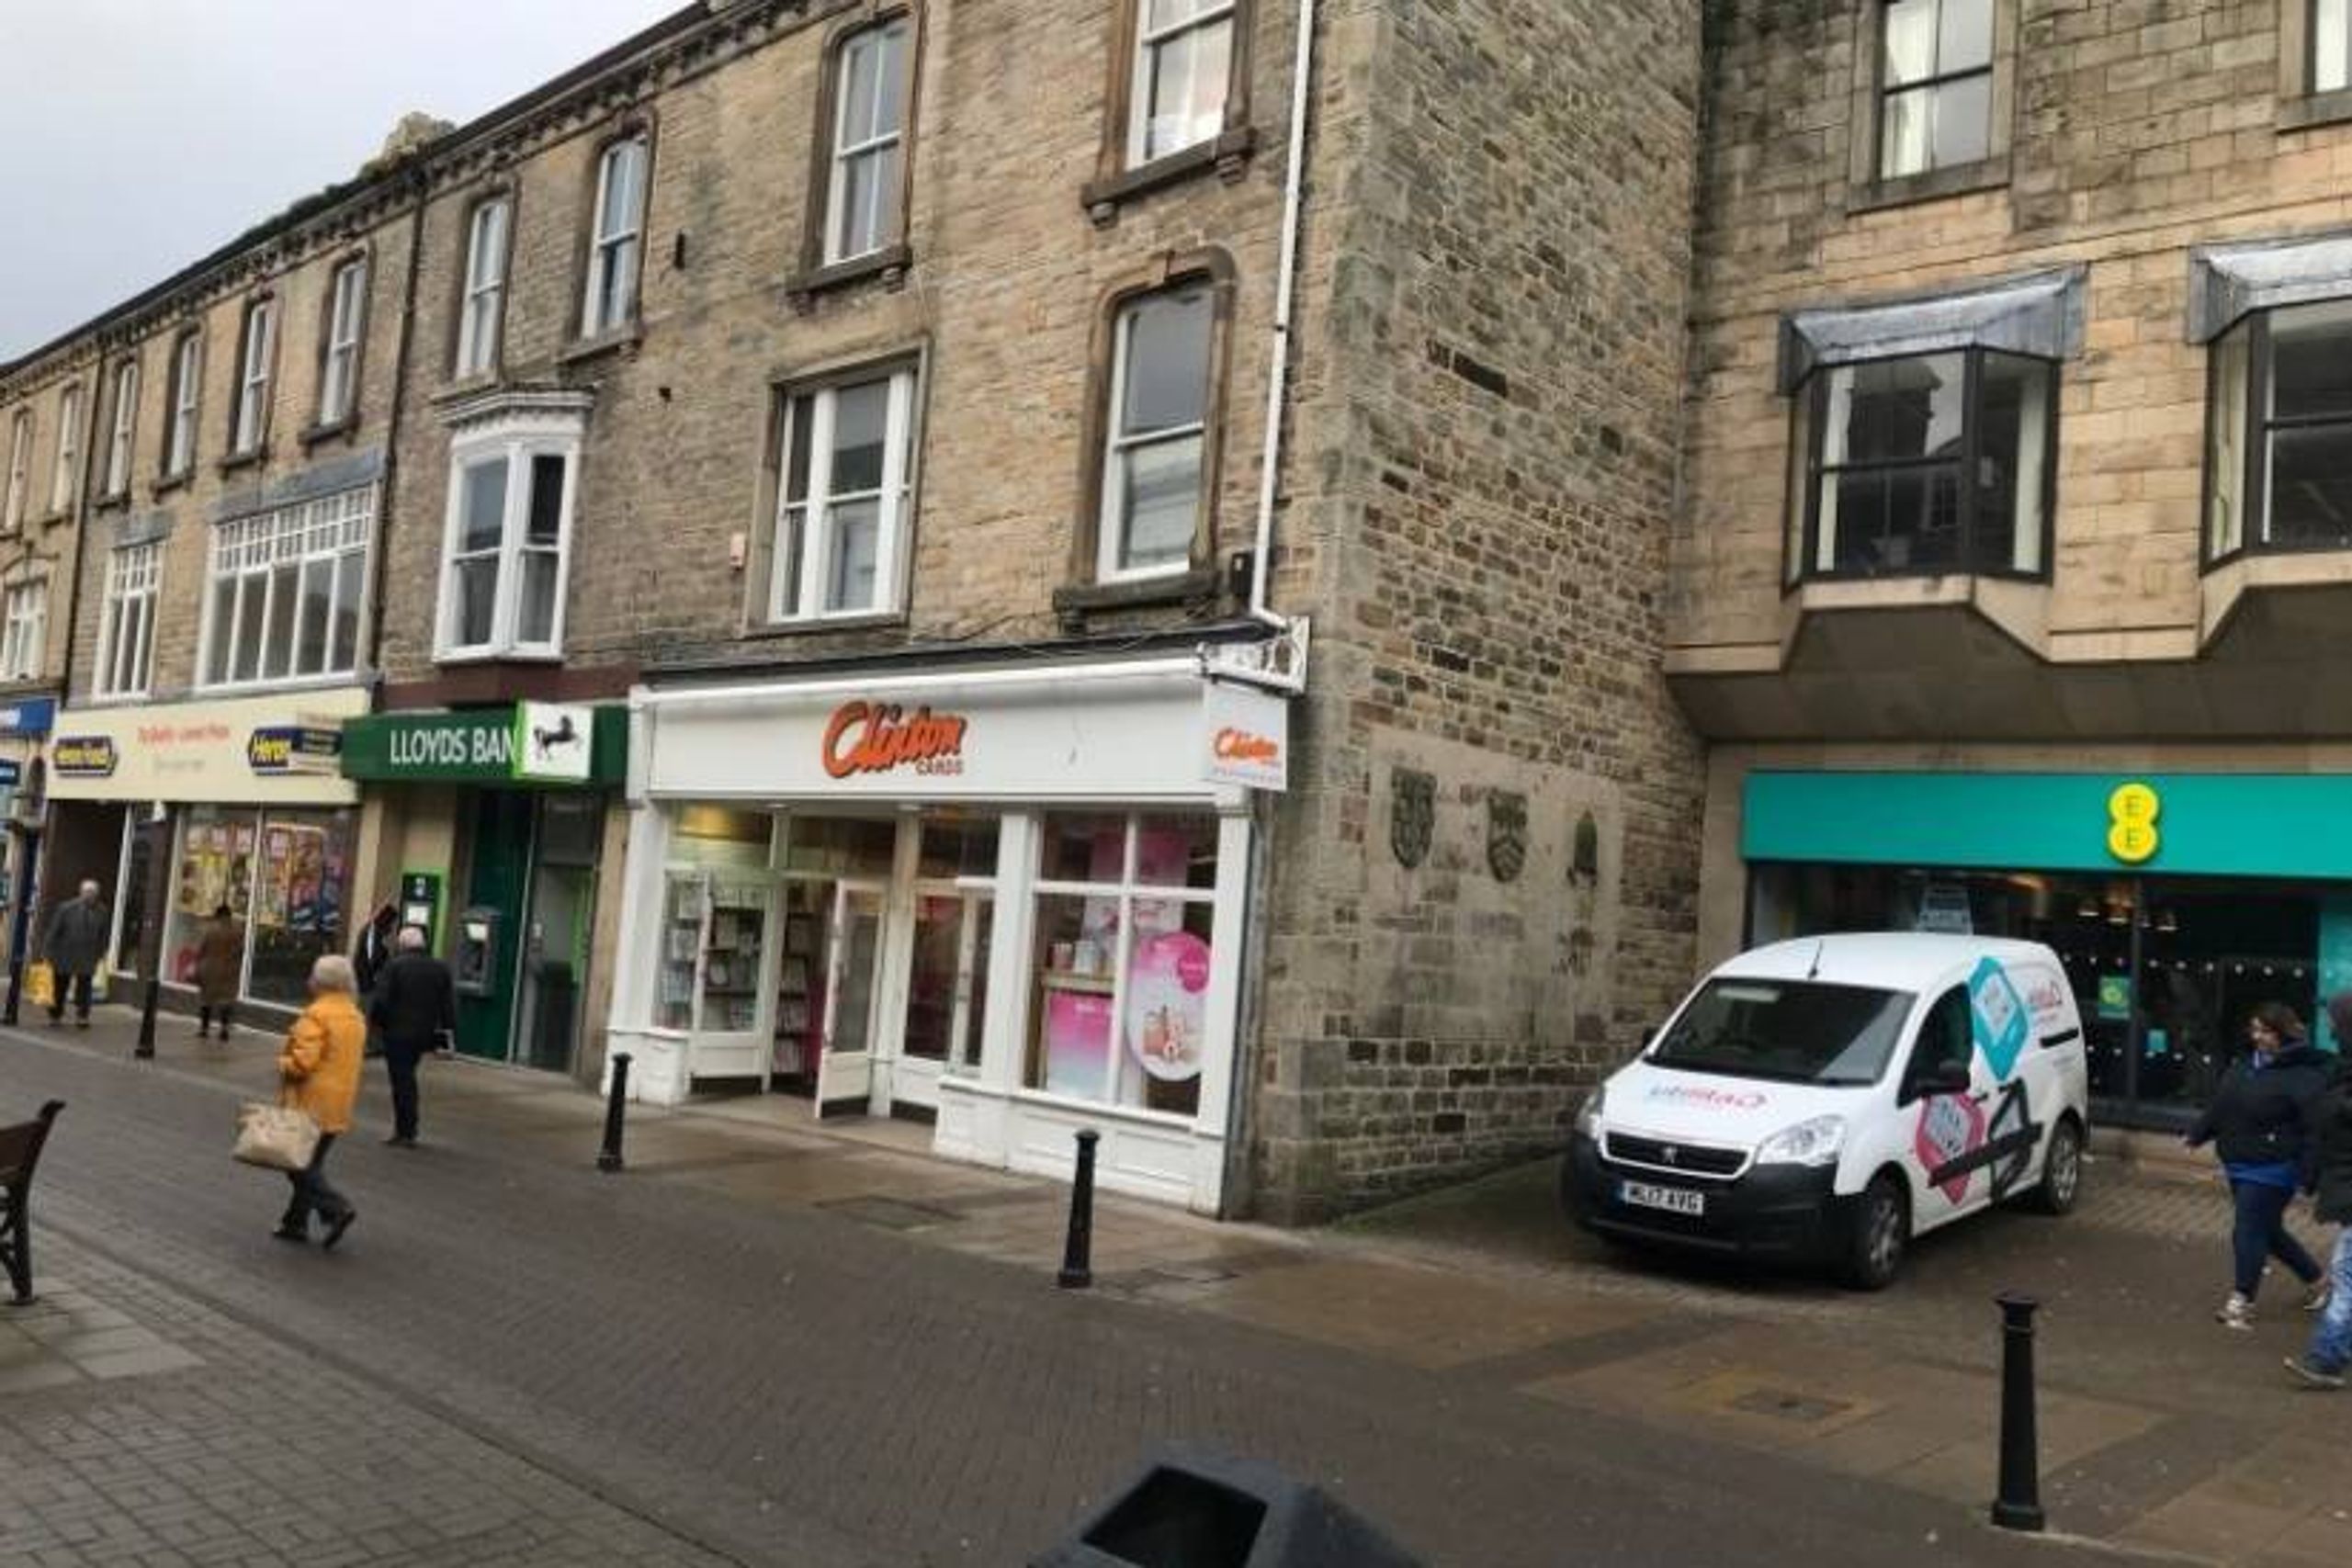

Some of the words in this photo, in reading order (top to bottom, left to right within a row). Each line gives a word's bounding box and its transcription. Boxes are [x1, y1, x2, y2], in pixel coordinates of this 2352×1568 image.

[390, 727, 467, 764] LLOYDS
[471, 728, 518, 763] BAN
[823, 701, 967, 779] Clinton
